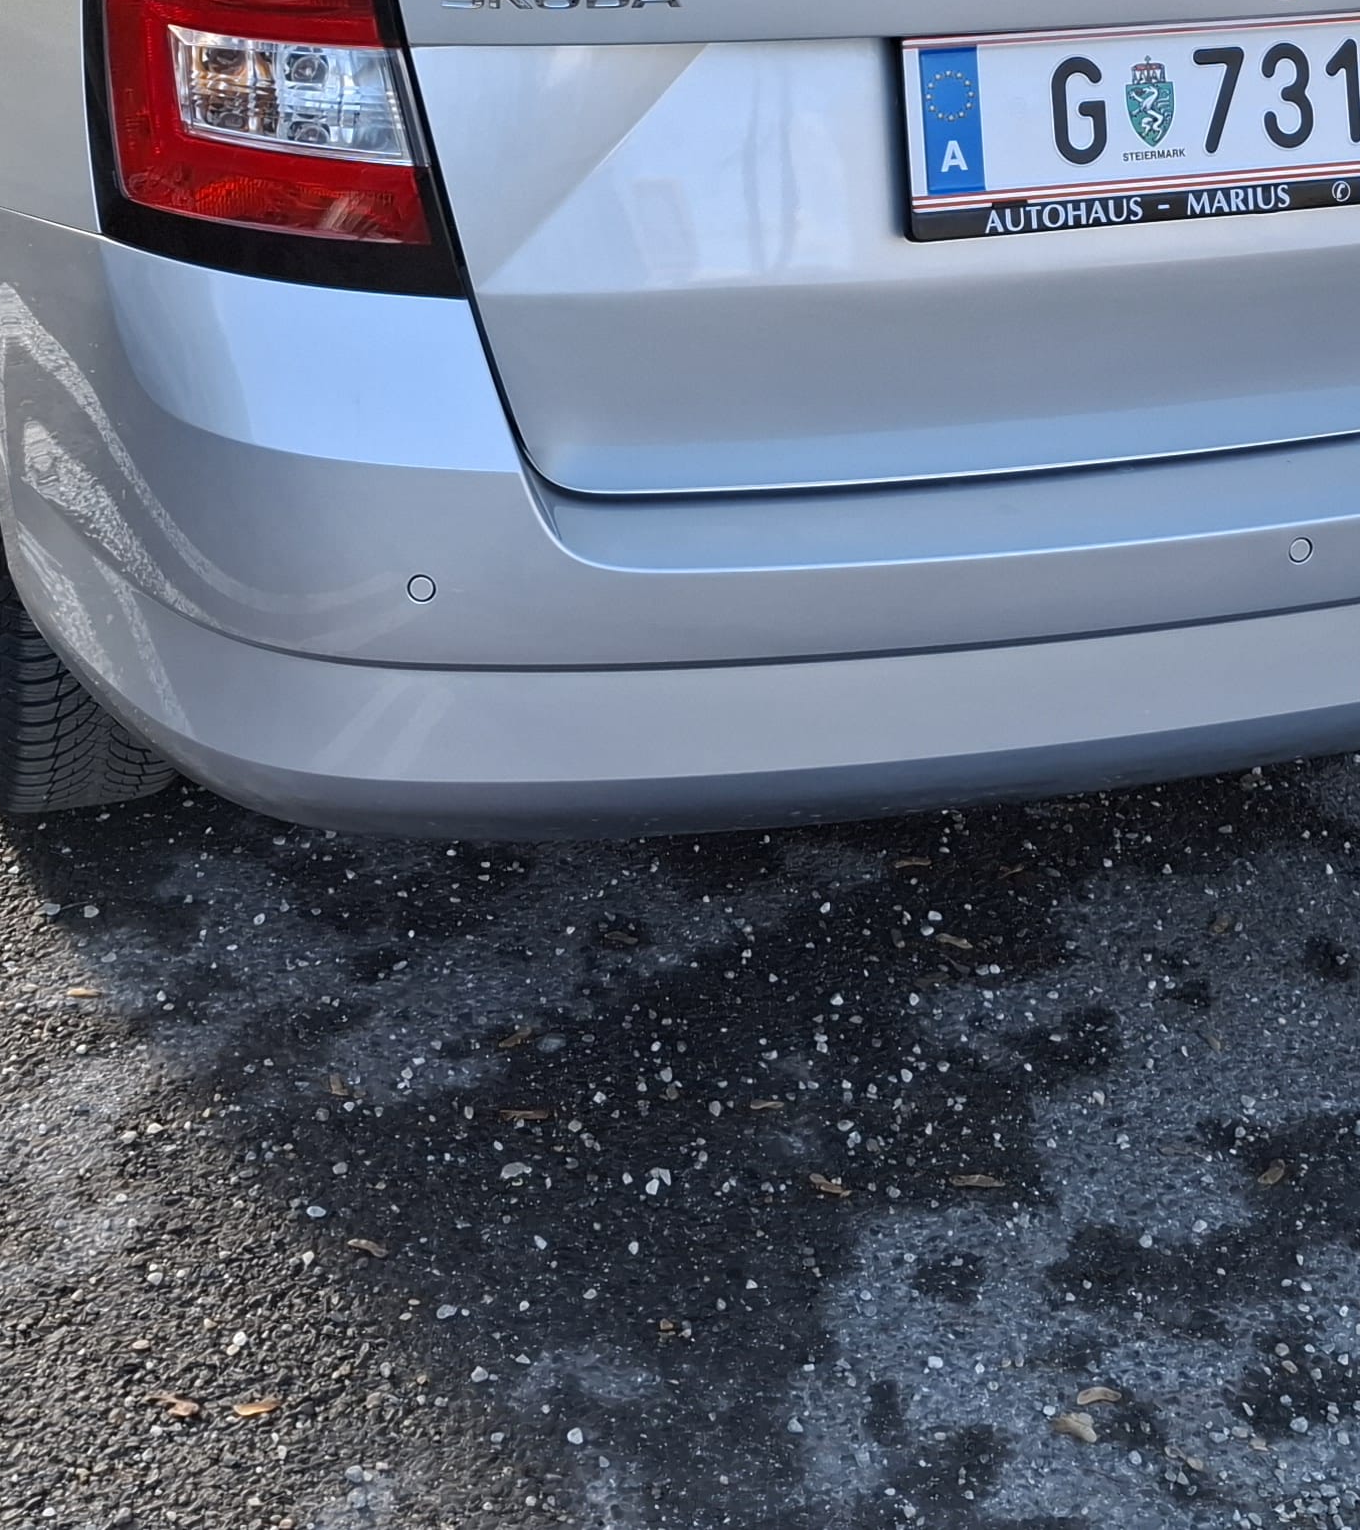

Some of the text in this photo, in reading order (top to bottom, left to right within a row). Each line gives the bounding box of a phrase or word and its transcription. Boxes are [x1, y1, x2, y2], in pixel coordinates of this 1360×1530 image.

[1051, 56, 1108, 166] G
[941, 139, 968, 173] A
[1122, 148, 1186, 162] STEIERMARK
[985, 197, 1144, 235] AUTOHAUS
[1185, 184, 1291, 216] MARIUS
